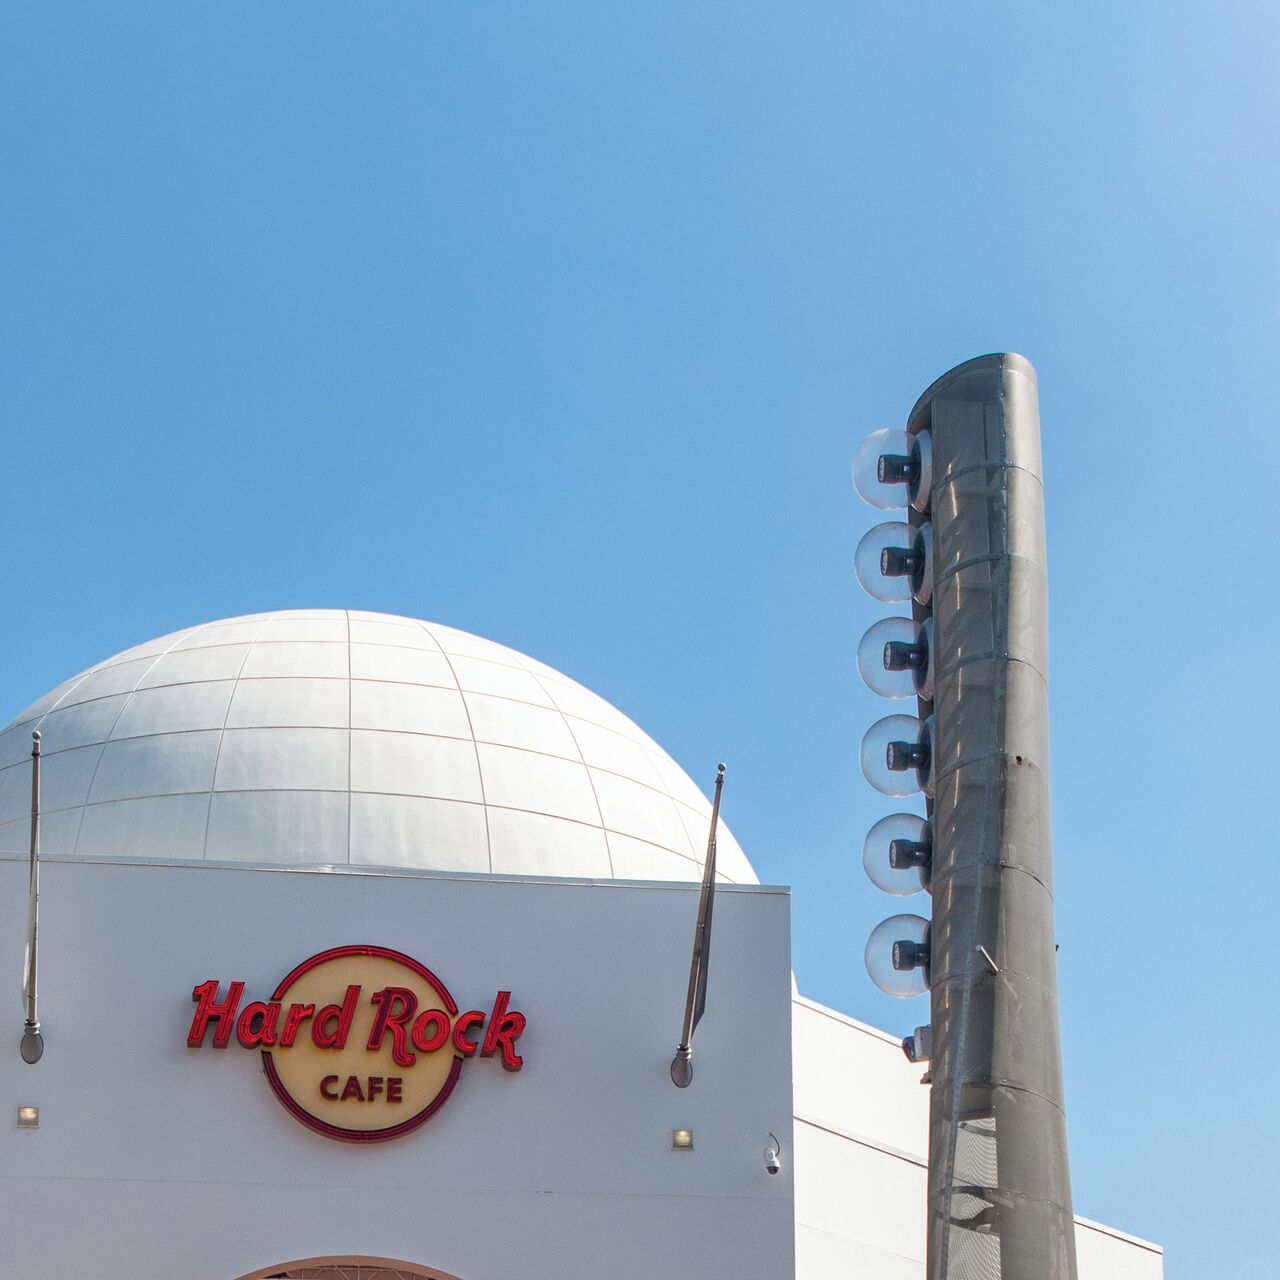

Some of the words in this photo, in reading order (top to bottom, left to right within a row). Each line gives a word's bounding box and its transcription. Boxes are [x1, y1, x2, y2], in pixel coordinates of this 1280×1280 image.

[187, 980, 361, 1049] Hard
[367, 986, 526, 1072] Rock
[320, 1075, 403, 1104] CAFE
